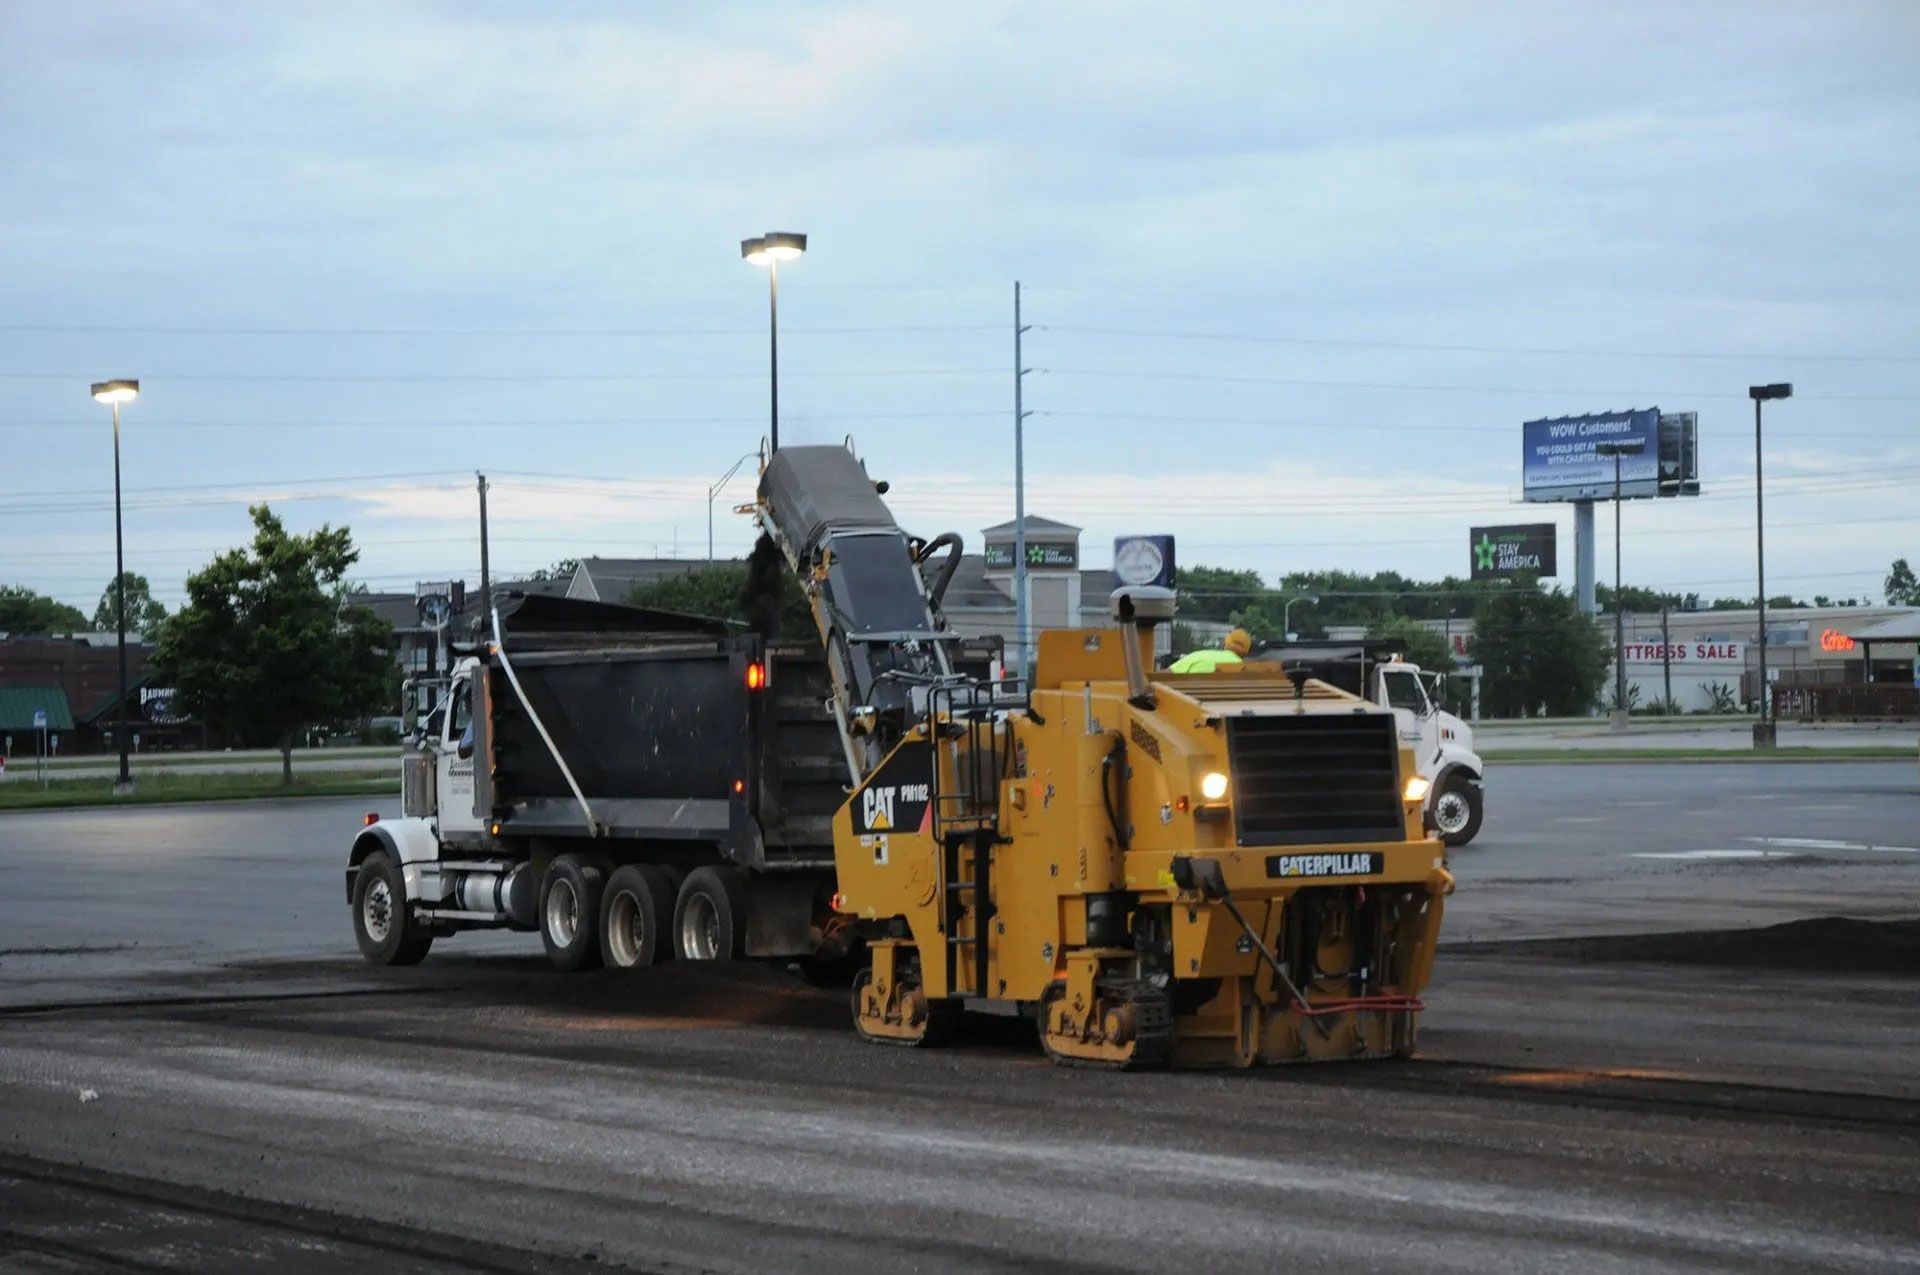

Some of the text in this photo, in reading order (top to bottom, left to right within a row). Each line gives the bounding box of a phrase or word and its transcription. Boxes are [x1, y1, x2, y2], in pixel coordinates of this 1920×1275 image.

[1549, 418, 1631, 438] WOW Customers!
[1498, 543, 1519, 556] STAY
[1498, 555, 1540, 570] AMERICA
[1696, 645, 1737, 659] SALE
[863, 787, 896, 830] CAT
[1279, 854, 1371, 877] CATERPILLAR
